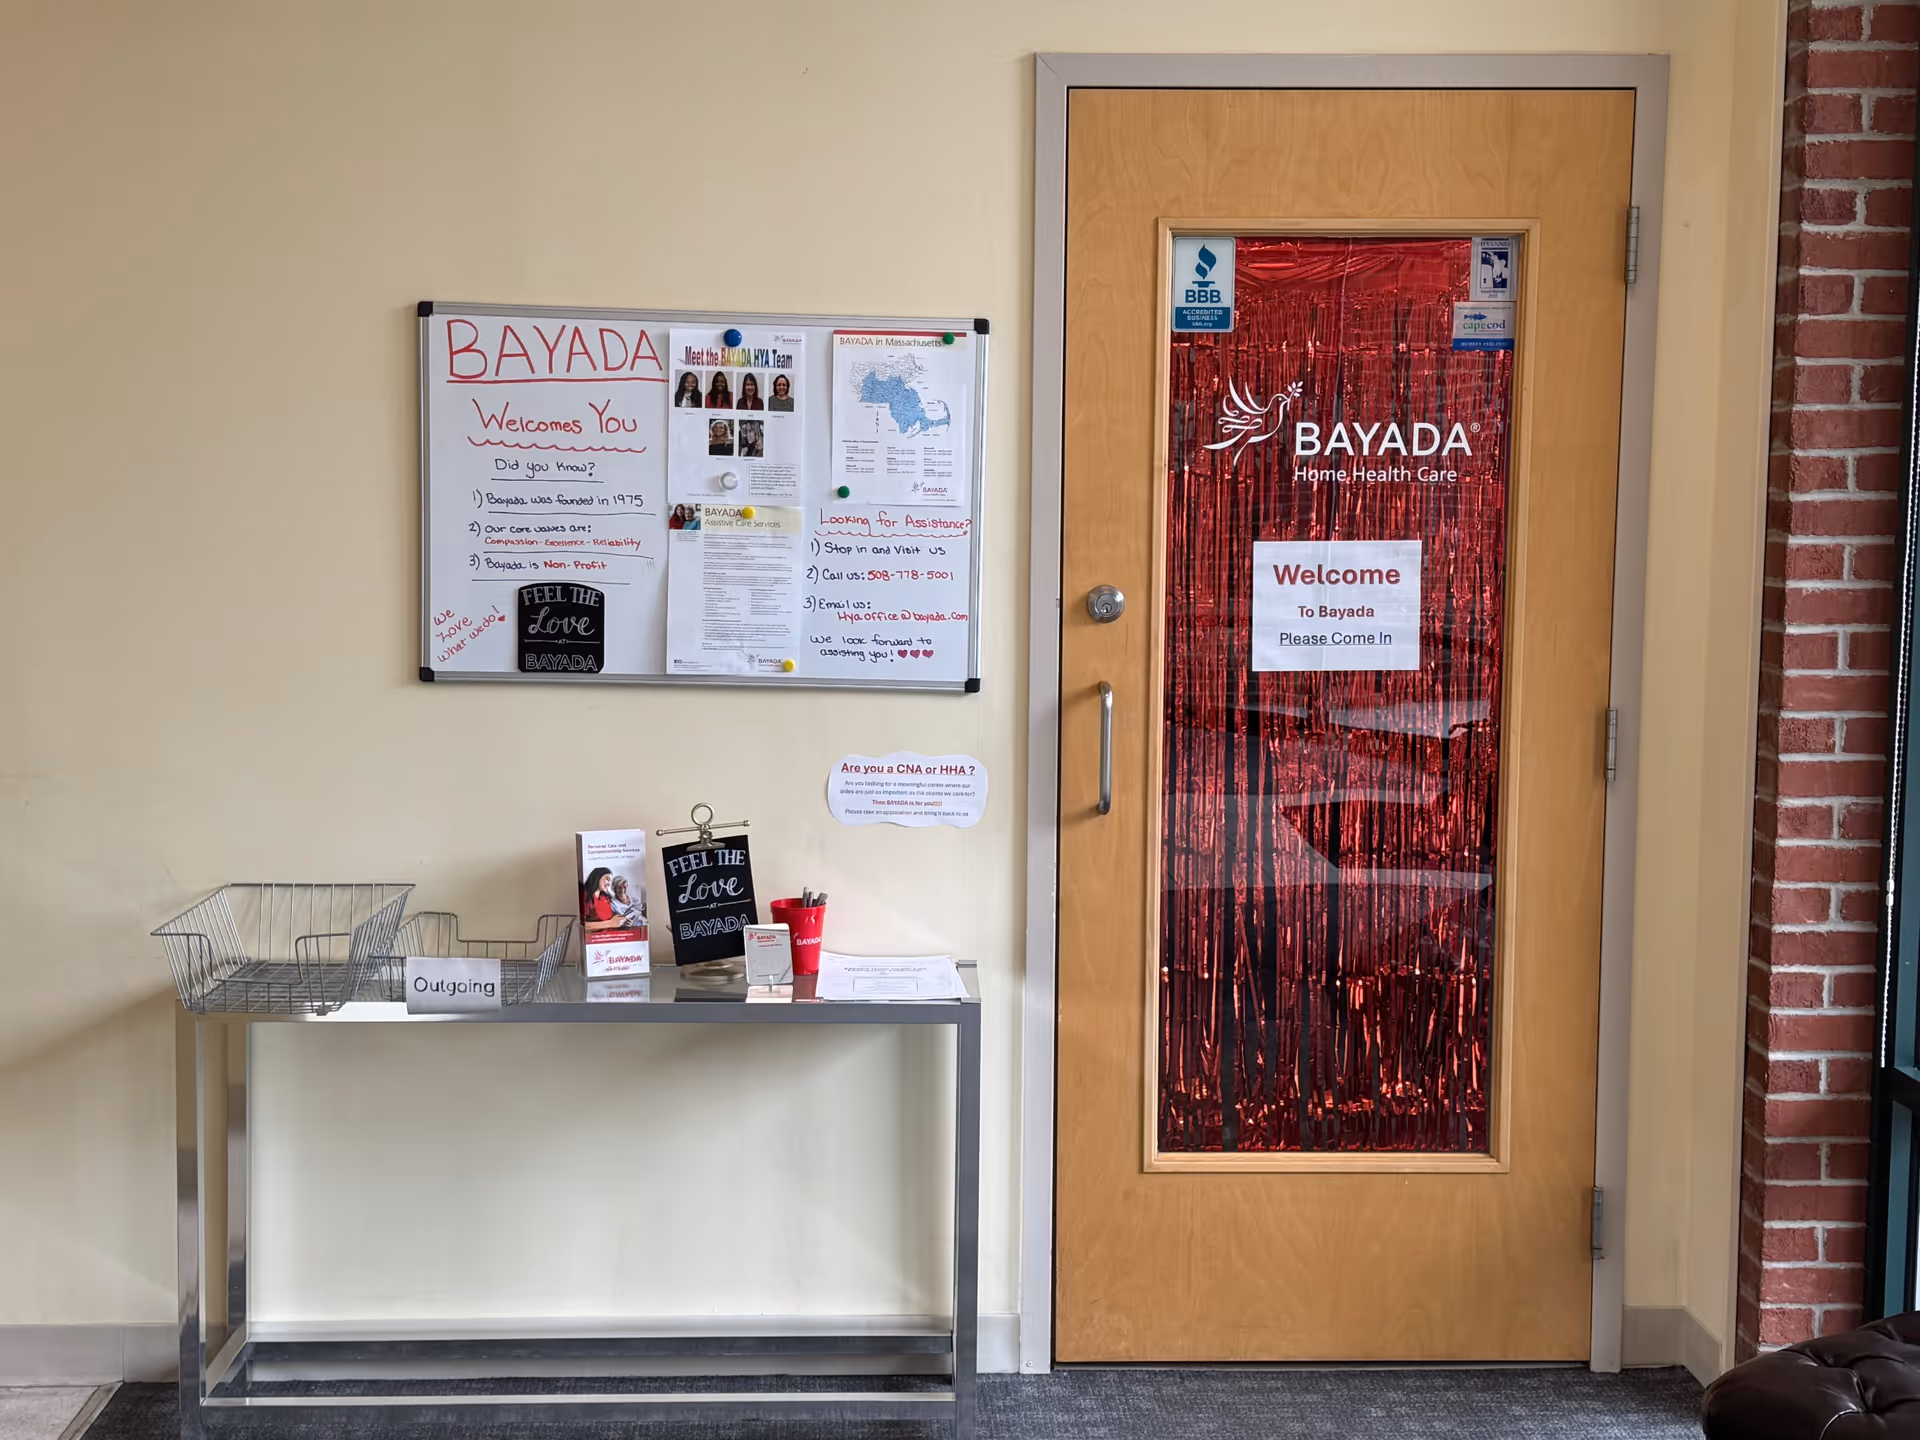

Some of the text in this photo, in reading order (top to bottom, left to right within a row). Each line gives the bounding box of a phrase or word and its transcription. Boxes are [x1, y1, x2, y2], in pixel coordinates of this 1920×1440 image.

[1185, 289, 1221, 303] BBB
[447, 319, 663, 379] BAYADA
[840, 337, 942, 348] BAYADA in Massachusetts
[685, 346, 793, 369] Meet the BAYADA HYA Team
[472, 399, 637, 434] Welcomes You
[495, 459, 519, 471] Did
[526, 462, 549, 479] you
[1294, 466, 1458, 482] Home Health Care
[472, 489, 644, 508] 1) Bayada was founded in 1975
[705, 508, 742, 518] BAYADA
[820, 508, 973, 536] Looking for Assistance?
[468, 521, 481, 537] 2)
[485, 525, 507, 534] Our
[534, 525, 566, 534] values
[569, 525, 592, 534] are:
[705, 519, 781, 529] Assistive Care Services
[810, 538, 820, 556] 1)
[823, 542, 853, 555] Stop
[871, 546, 890, 555] and
[894, 544, 921, 555] Visit
[928, 545, 946, 555] us
[469, 553, 481, 572] 3)
[485, 557, 526, 572] Bayada
[526, 561, 539, 570] is
[806, 565, 819, 584] 2)
[822, 568, 843, 581] Call
[846, 571, 865, 581] us:
[867, 570, 954, 582] 508-778-5001
[1273, 564, 1401, 586] Welcome
[521, 585, 600, 607] FEEL THE
[803, 595, 871, 613] 3) Email us:
[528, 605, 595, 636] Love
[1298, 605, 1375, 620] To Bayada
[842, 637, 867, 645] look
[871, 634, 913, 646] forward
[917, 637, 932, 645] to
[1279, 631, 1393, 645] Please Come In
[525, 653, 598, 672] BAYADA
[820, 649, 894, 664] assisting you!
[841, 763, 861, 773] Are
[864, 765, 884, 775] you
[897, 764, 923, 774] CNA
[926, 766, 938, 774] or
[940, 765, 966, 774] HHA
[667, 849, 746, 877] FEEL THE
[678, 872, 745, 904] Love
[680, 913, 750, 940] BAYADA
[608, 955, 642, 964] BAYADA
[413, 976, 496, 996] Outgoing
